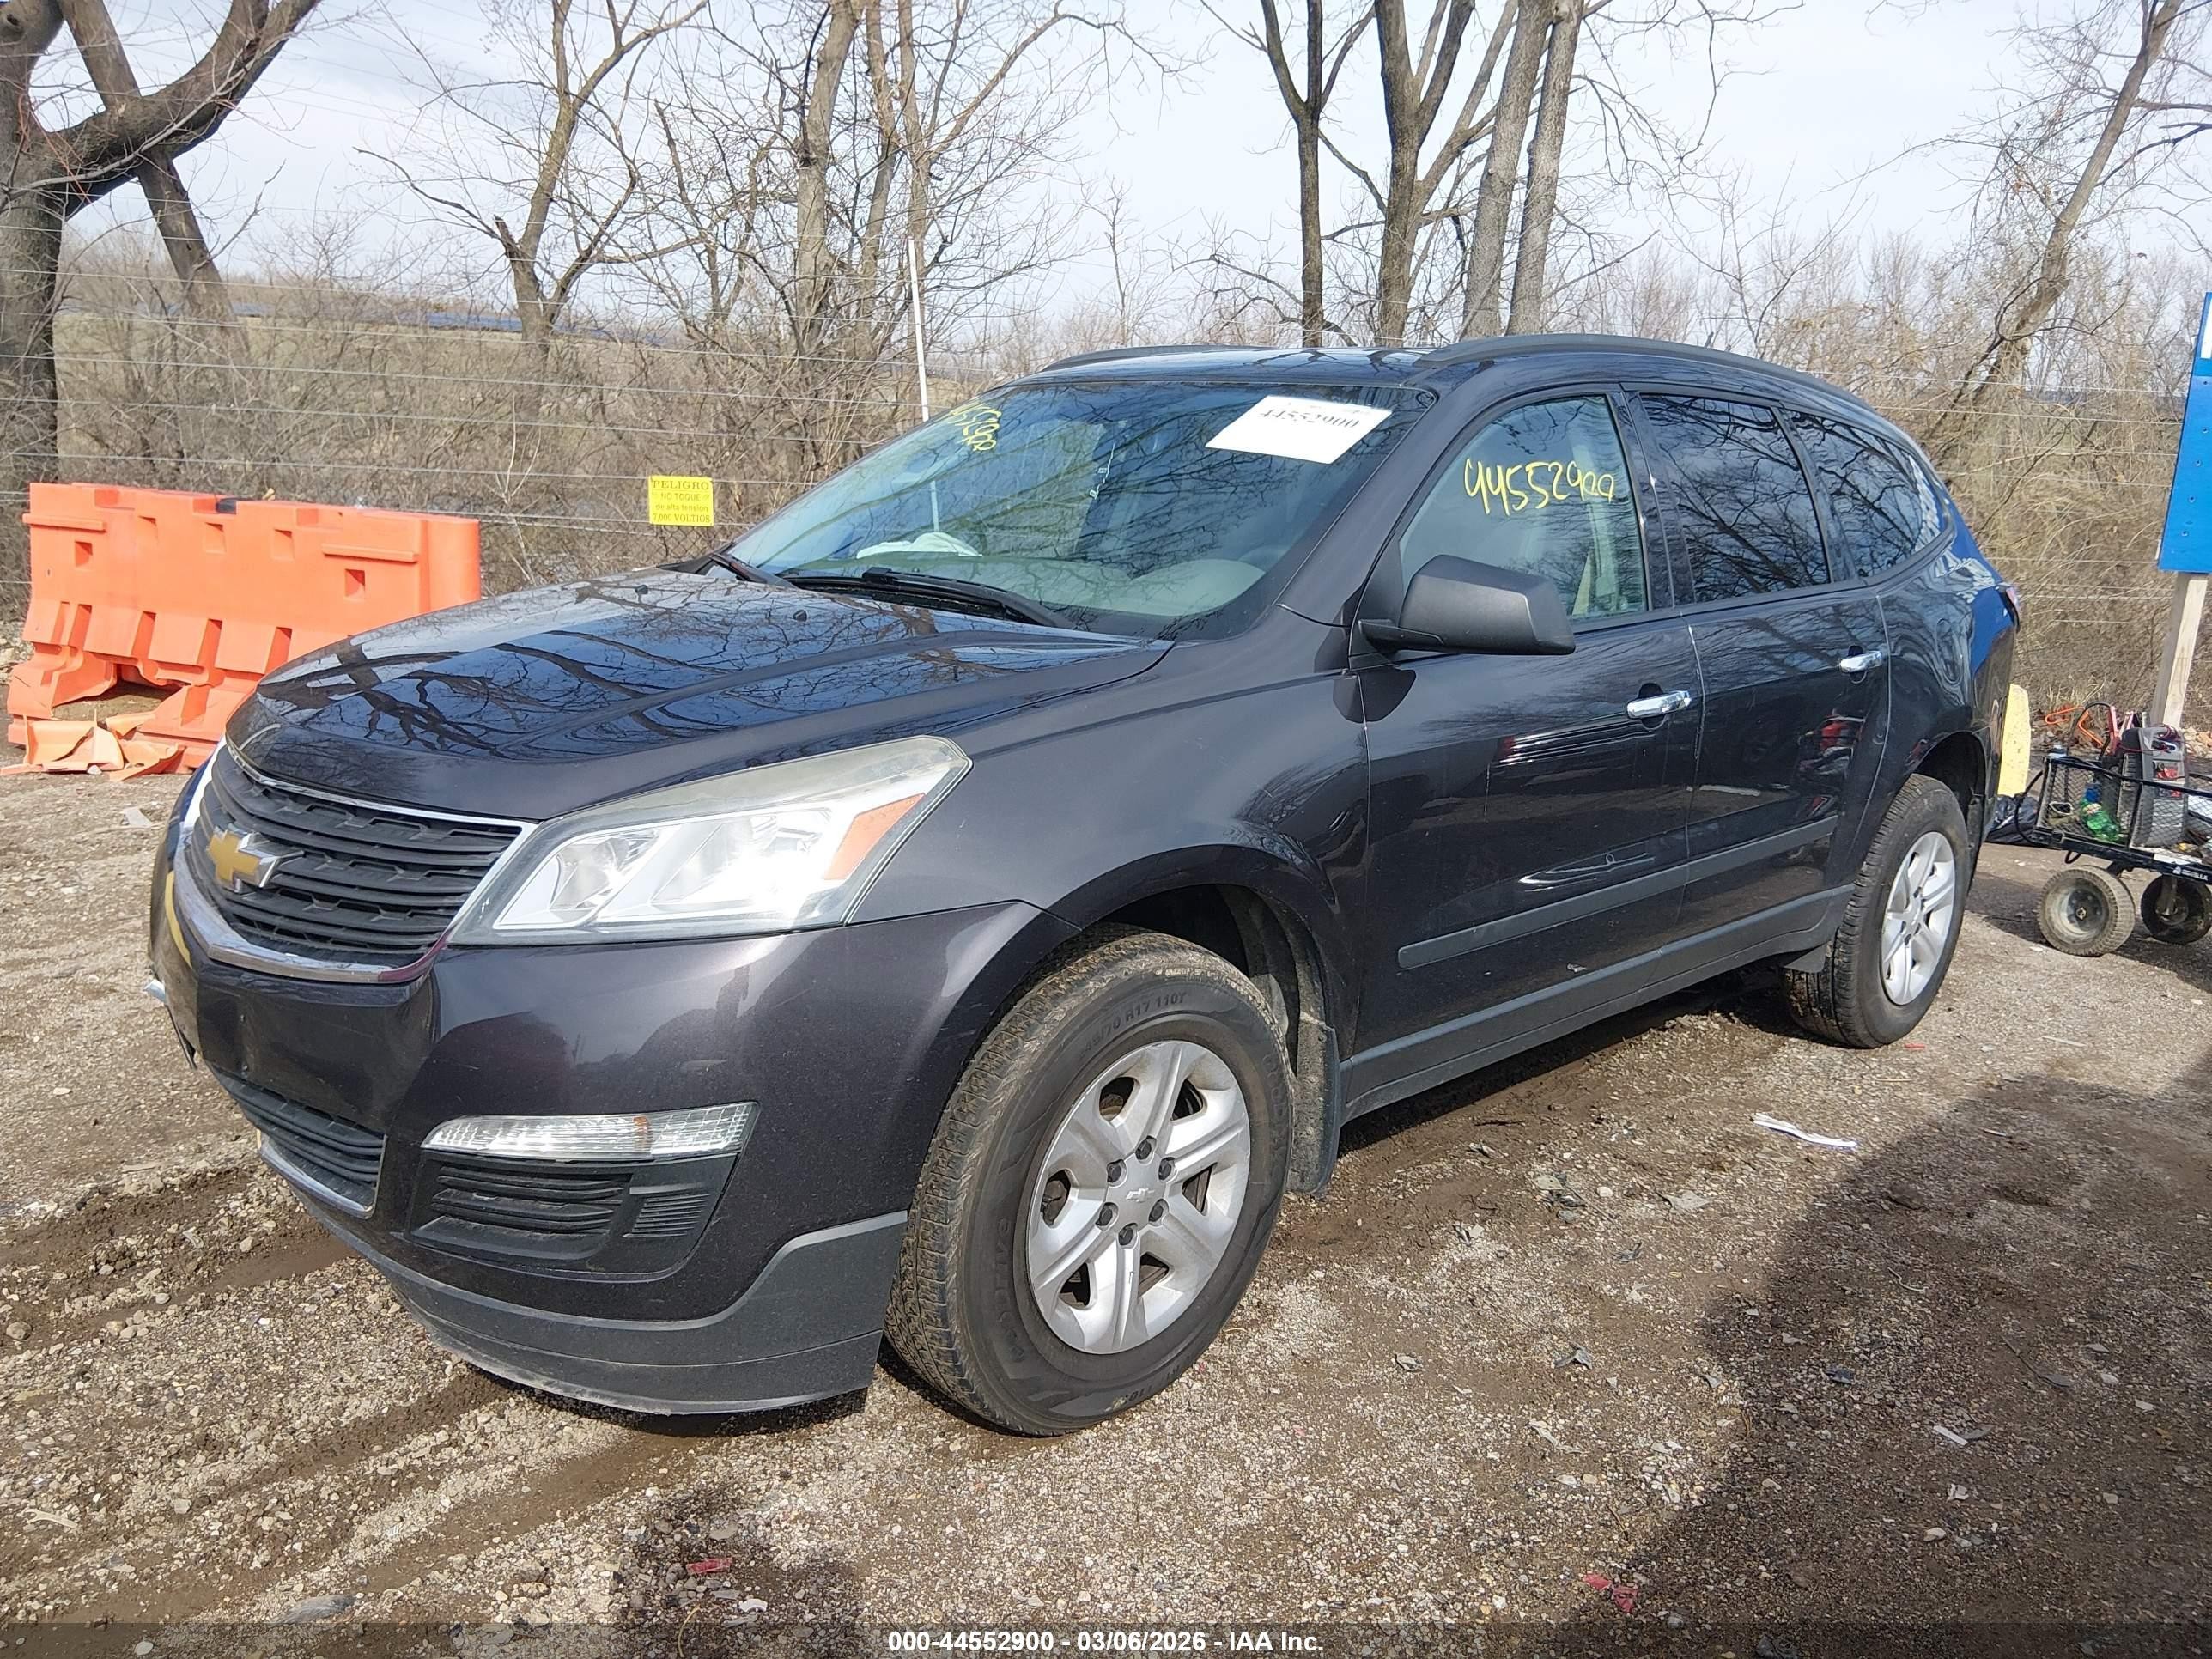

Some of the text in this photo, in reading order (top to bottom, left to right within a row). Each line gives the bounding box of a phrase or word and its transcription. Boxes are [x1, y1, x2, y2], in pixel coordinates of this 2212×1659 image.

[1260, 409, 1360, 428] 44552900
[653, 480, 709, 489] PELIGRO
[1463, 459, 1614, 515] 44552900
[660, 492, 701, 501] NO TOQUE
[673, 514, 711, 523] VOLTIOS
